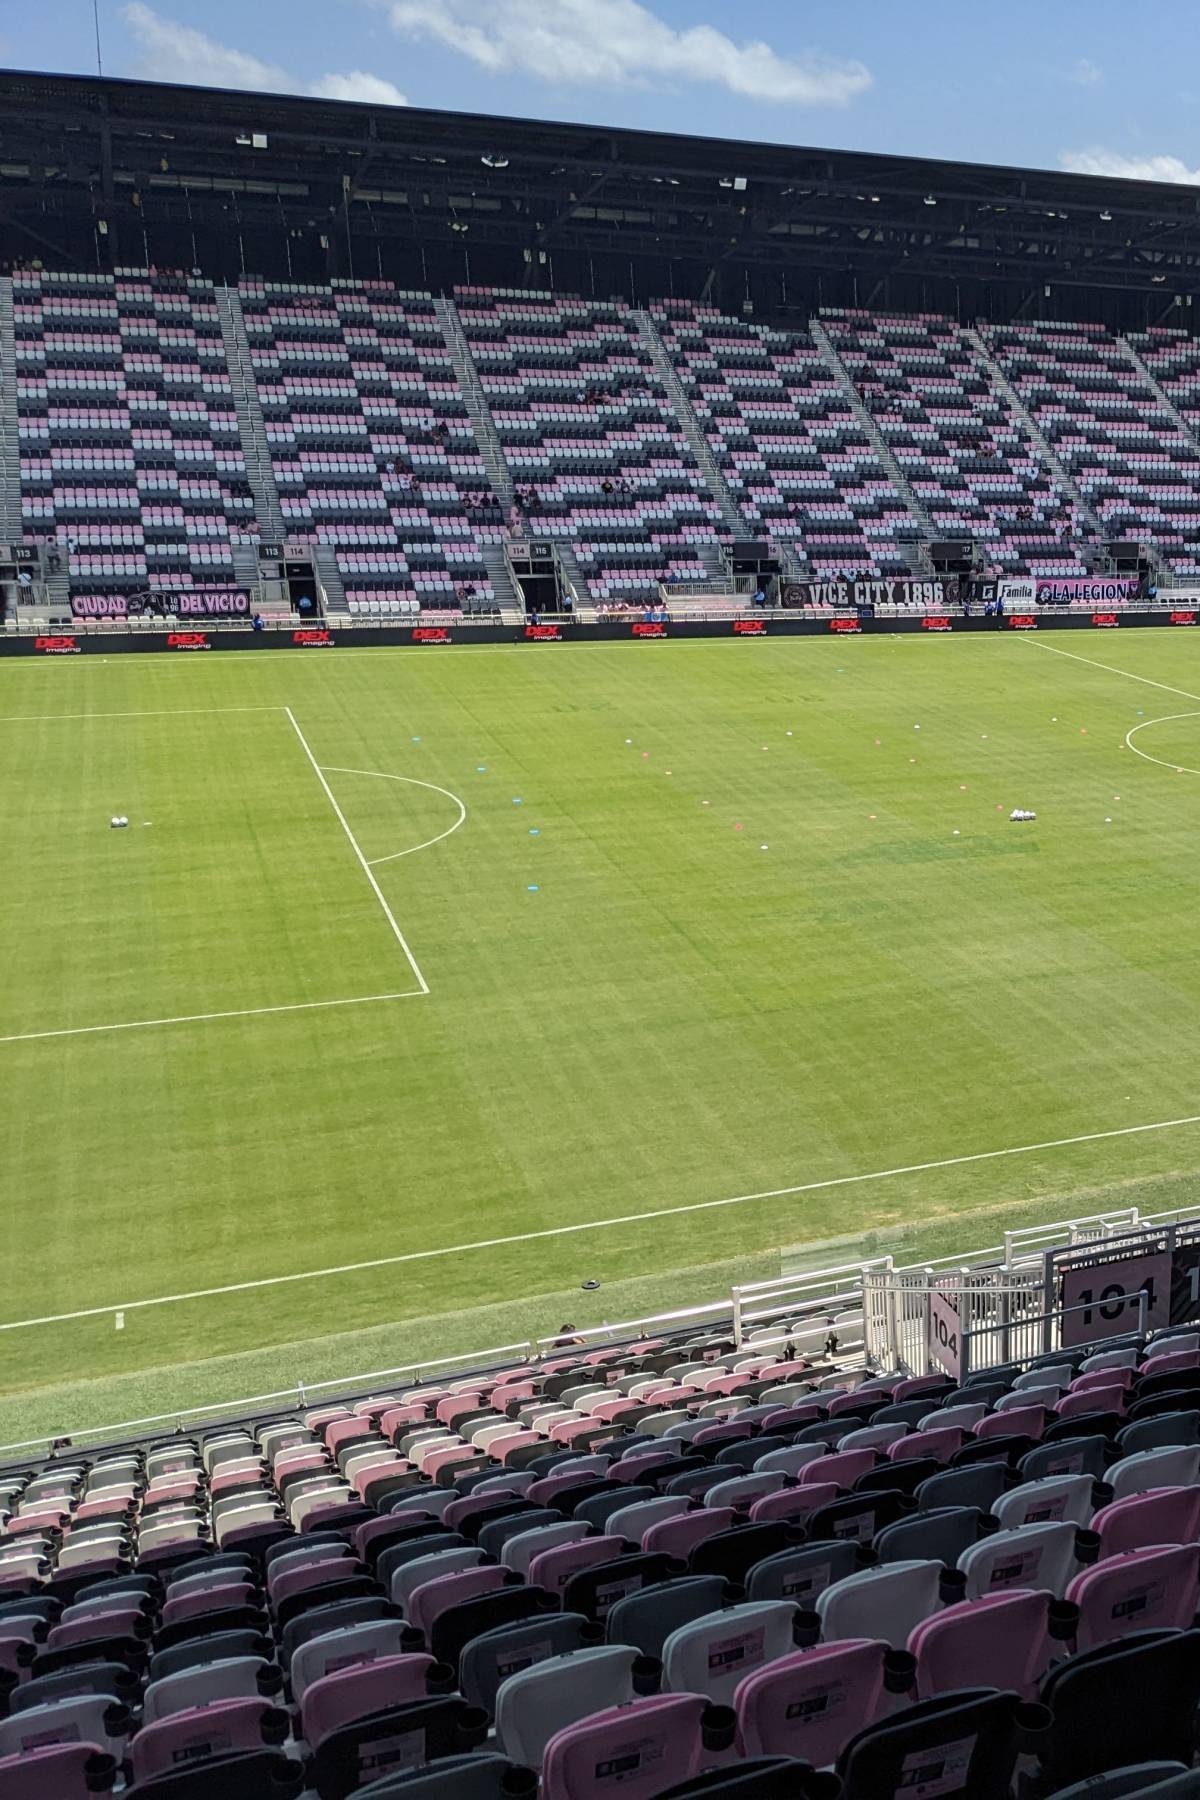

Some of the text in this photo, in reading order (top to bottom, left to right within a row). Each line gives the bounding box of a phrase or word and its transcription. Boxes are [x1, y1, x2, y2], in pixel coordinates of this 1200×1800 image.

[16, 549, 31, 558] 113
[265, 547, 279, 556] 113
[290, 547, 304, 555] 114
[513, 547, 525, 555] 114
[535, 547, 547, 555] 115
[809, 582, 944, 605] VICE CITY 1896
[1002, 585, 1032, 598] Familia
[1052, 583, 1127, 600] LA LEGION
[73, 595, 128, 614] CIUDAD
[1009, 617, 1035, 625] DEX
[1092, 615, 1117, 623] DEX
[1170, 613, 1194, 621] DEX
[734, 622, 764, 631] DEX
[830, 620, 859, 629] DEX
[921, 618, 949, 627] DEX
[526, 627, 559, 637] DEX
[632, 624, 664, 634] DEX
[293, 631, 330, 642] DEX
[412, 629, 447, 640] DEX
[36, 638, 76, 649] DEX
[168, 634, 206, 645] DEX
[46, 647, 81, 655] imaging
[1078, 1276, 1158, 1325] 104
[933, 1311, 958, 1359] 104
